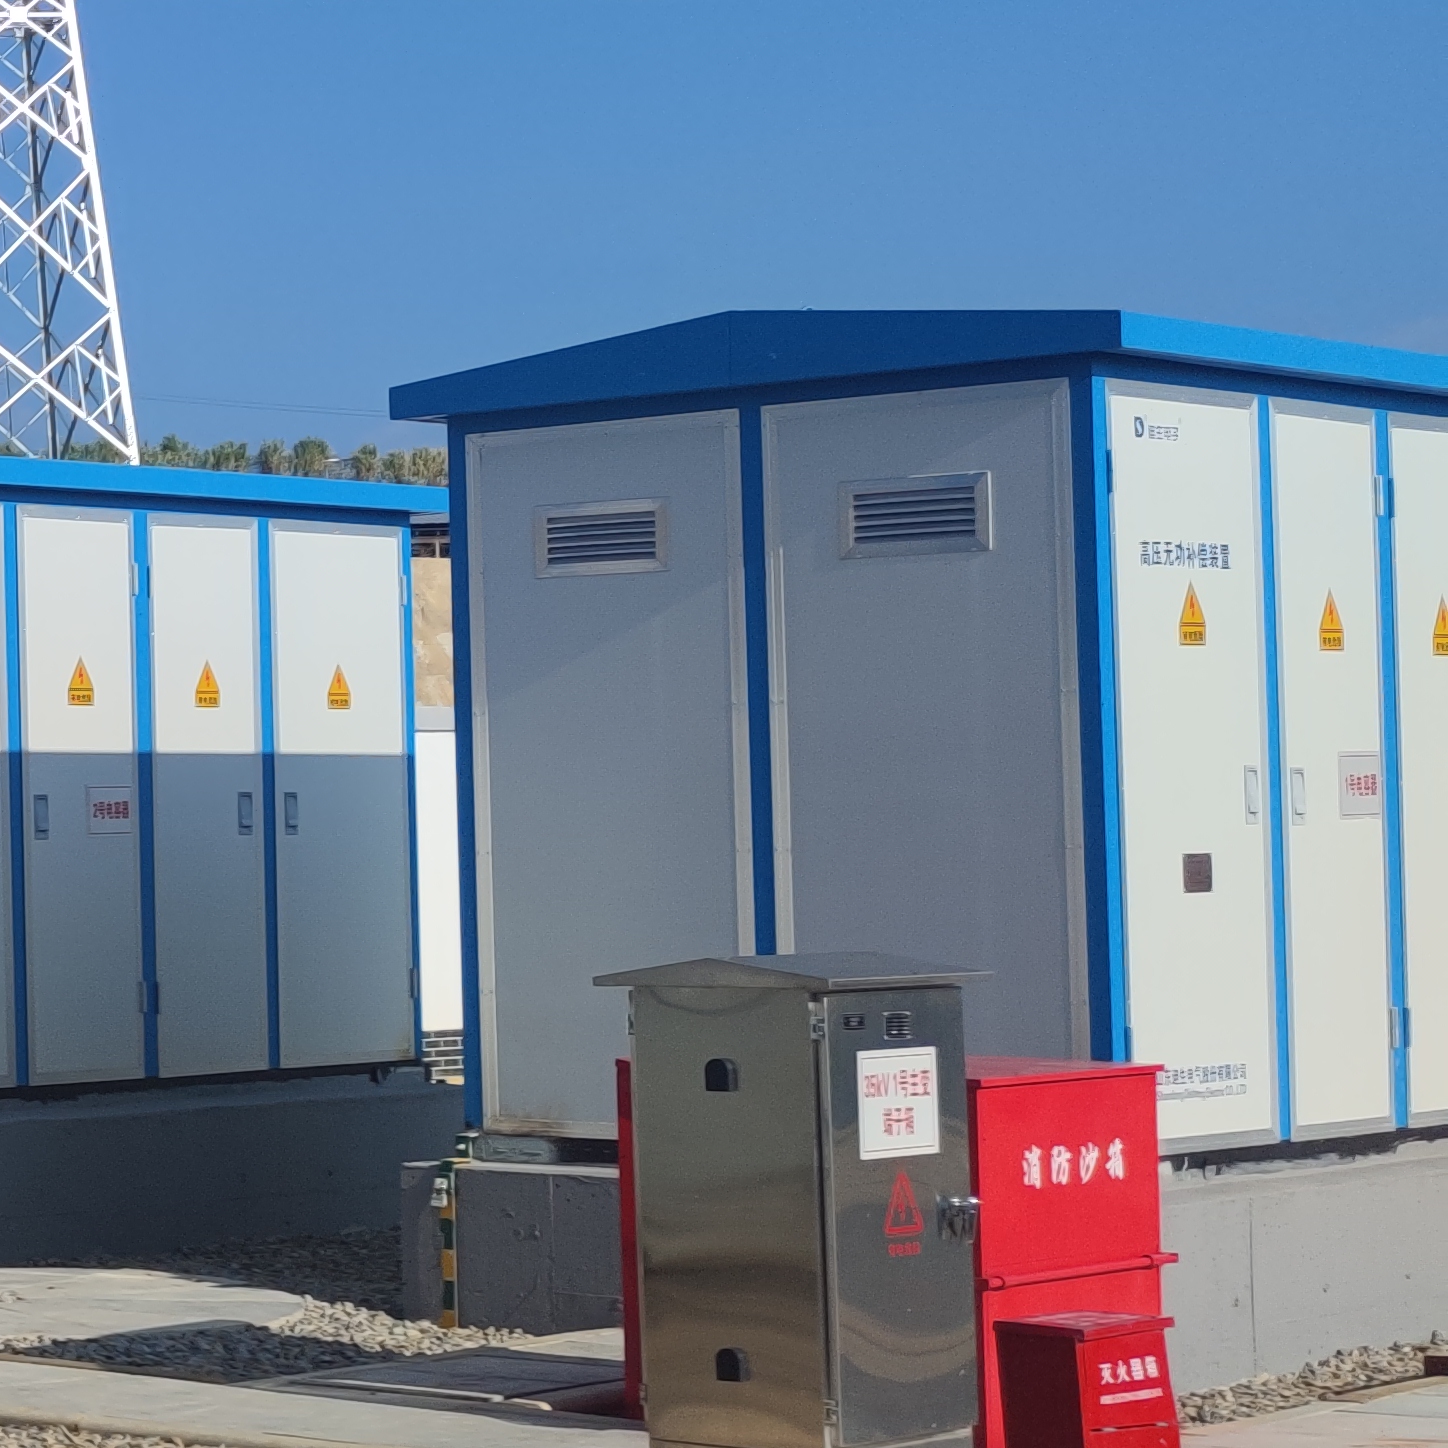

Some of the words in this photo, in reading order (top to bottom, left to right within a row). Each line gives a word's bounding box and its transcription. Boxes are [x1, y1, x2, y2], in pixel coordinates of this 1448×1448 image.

[1138, 540, 1231, 570] 高压无功补偿装置
[864, 1072, 890, 1098] 35kV
[892, 1069, 931, 1097] 1号主变
[882, 1107, 915, 1136] 端子箱
[1021, 1137, 1126, 1190] 消防沙箱
[1097, 1355, 1160, 1385] 灭火器箱
